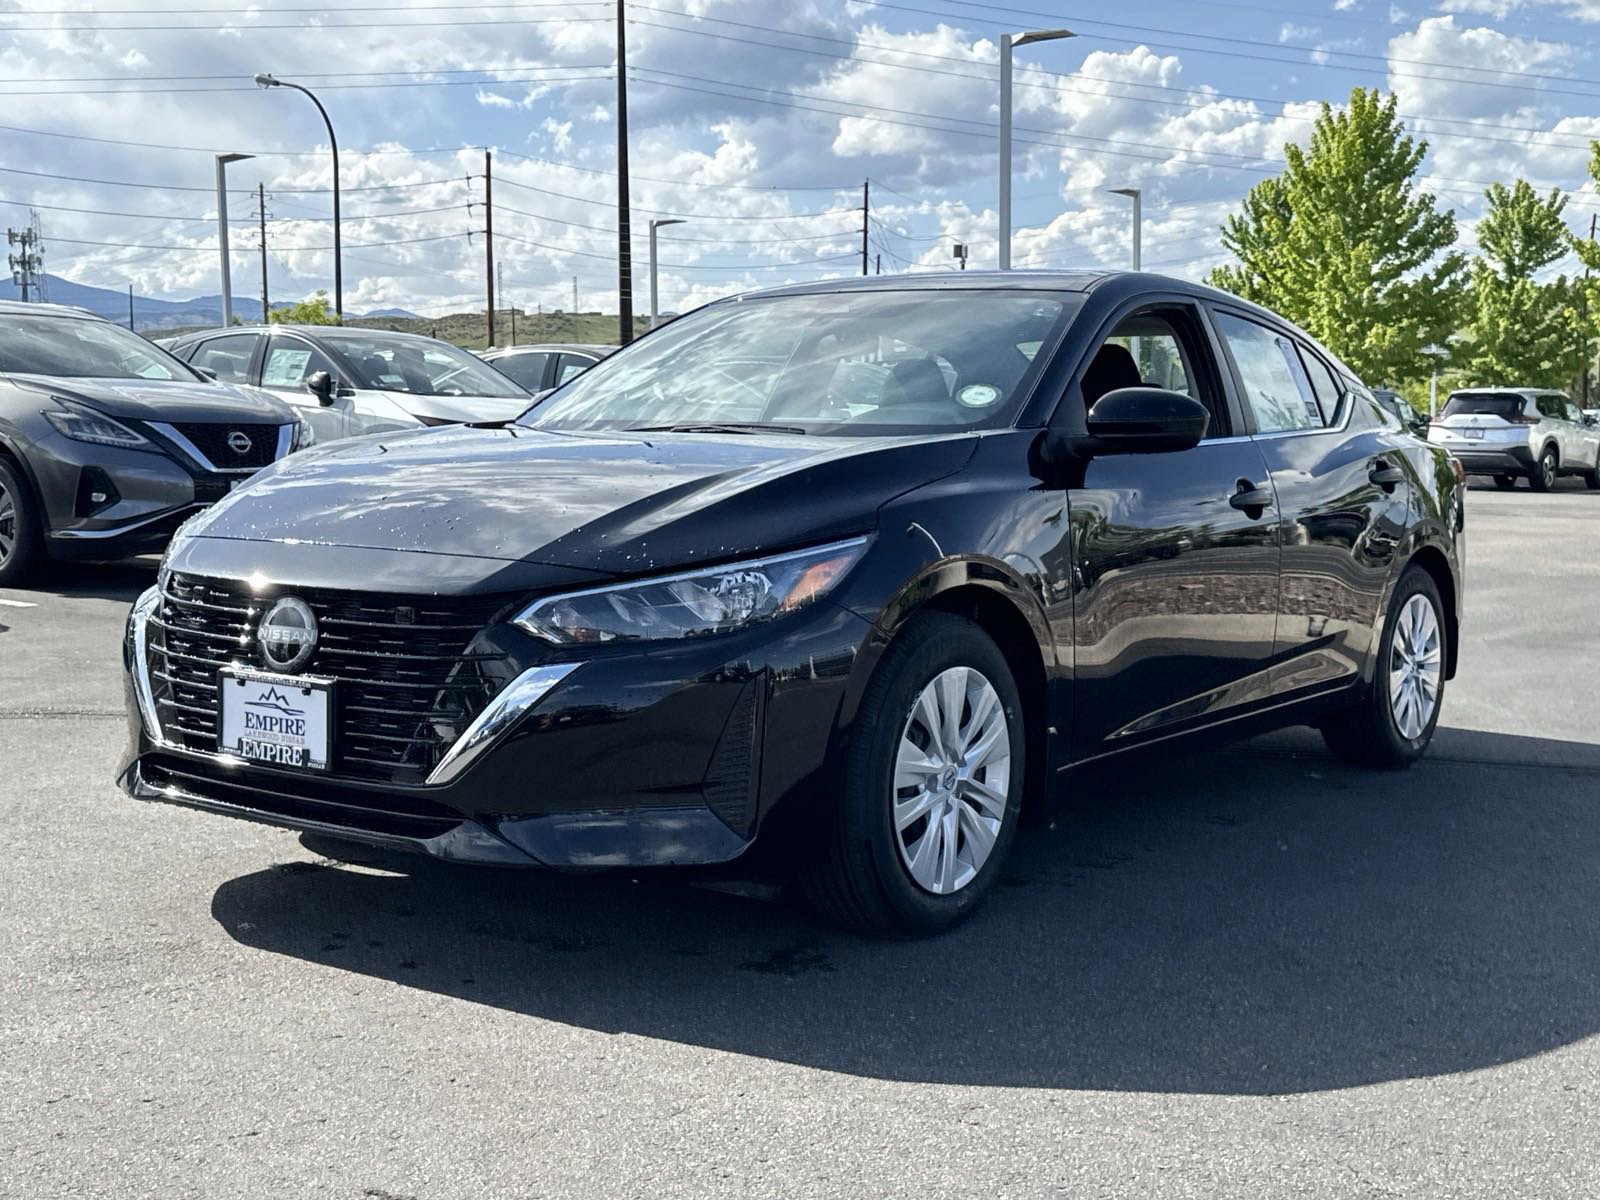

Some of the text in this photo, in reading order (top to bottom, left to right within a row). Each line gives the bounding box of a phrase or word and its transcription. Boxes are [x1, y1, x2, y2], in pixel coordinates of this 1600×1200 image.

[258, 627, 314, 642] NISSAN
[244, 711, 306, 736] EMPIRE
[241, 738, 303, 767] EMPIRE
